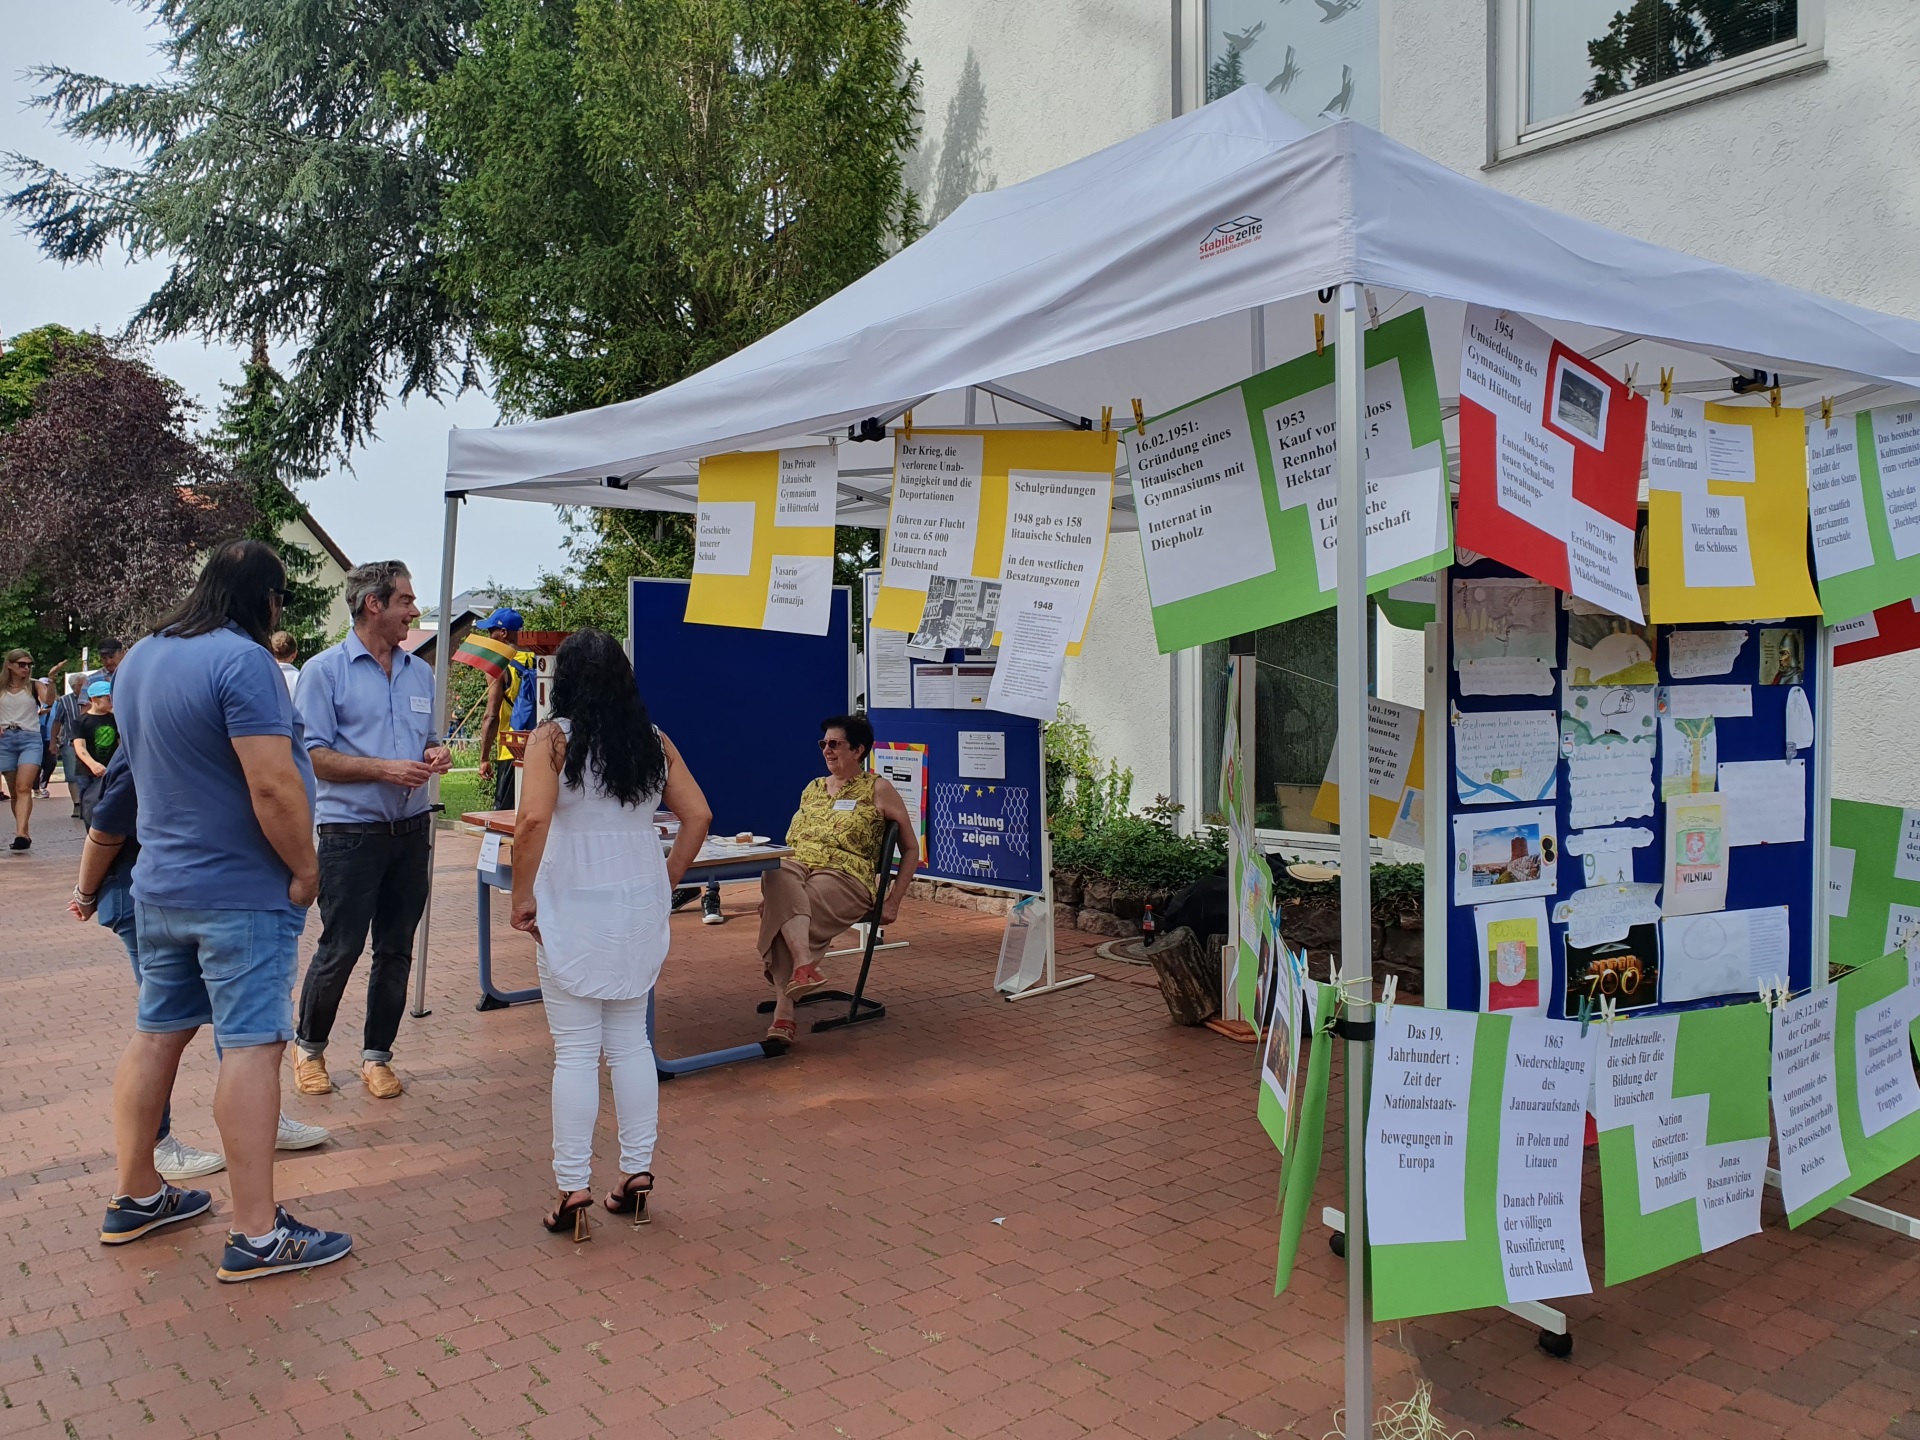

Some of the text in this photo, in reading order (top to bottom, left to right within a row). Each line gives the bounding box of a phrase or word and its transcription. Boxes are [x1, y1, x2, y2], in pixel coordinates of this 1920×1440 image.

[1200, 224, 1262, 254] stabilezelte
[1200, 235, 1261, 260] www.stabilezelte.de
[1494, 319, 1514, 340] 1954
[1470, 324, 1538, 377] Umsiedelung des
[1468, 345, 1521, 388] Gymnasiums
[1466, 367, 1531, 414] nach Hüttenfeld
[1276, 410, 1305, 432] 1953
[1671, 408, 1683, 419] 1984
[1135, 421, 1199, 454] 16.02.1951:
[1651, 421, 1697, 439] Beschädigung des
[1279, 427, 1311, 451] Kauf
[1524, 431, 1548, 454] 1963-65
[1651, 437, 1692, 453] Schlosses durch
[1878, 434, 1890, 444] Das
[902, 445, 956, 457] Der Krieg, die
[1138, 428, 1231, 471] Gründung eines
[1502, 434, 1555, 474] Entstehung eines
[782, 459, 816, 470] Das Private
[902, 460, 964, 472] verlorene Unab-
[1502, 452, 1521, 470] neuen
[1652, 455, 1697, 470] einen Großbrand
[782, 474, 812, 484] Litauische
[901, 475, 972, 488] hängigkeit und die
[1141, 459, 1203, 489] litauischen
[1286, 464, 1331, 488] Hektar
[1841, 473, 1857, 485] Status
[1015, 482, 1096, 497] Schulgründungen
[1144, 461, 1245, 506] Gymnasiums mit
[1906, 485, 1916, 494] das
[781, 489, 816, 501] Gymnasium
[899, 489, 954, 502] Deportationen
[1502, 485, 1532, 507] gebäudes
[780, 502, 819, 513] in Hüttenfeld
[1705, 507, 1720, 518] 1989
[1814, 506, 1827, 516] einer
[701, 512, 710, 521] Die
[897, 515, 965, 529] führen zur Flucht
[1013, 513, 1033, 524] 1948
[1035, 516, 1051, 528] gab
[1066, 517, 1082, 527] 158
[1149, 504, 1212, 534] Internat in
[700, 526, 730, 535] Geschichte
[895, 531, 949, 542] von ca. 65 000
[1011, 528, 1092, 545] litauische Schulen
[1151, 526, 1204, 551] Diepholz
[1585, 521, 1616, 545] 1972/1987
[1692, 524, 1738, 536] Wiederaufbau
[699, 540, 720, 548] unserer
[1571, 530, 1618, 564] Errichtung des
[1695, 542, 1738, 553] des Schlosses
[1817, 531, 1851, 548] Ersatzschule
[698, 552, 716, 561] Schule
[893, 543, 947, 558] Litauern nach
[775, 566, 797, 576] Vasario
[891, 557, 938, 572] Deutschland
[1008, 555, 1084, 572] in den westlichen
[774, 581, 797, 590] 16-osios
[1006, 570, 1080, 588] Besatzungszonen
[1574, 565, 1633, 602] Mädcheninternats
[771, 594, 803, 607] Gimnazija
[1033, 601, 1053, 610] 1948
[1383, 770, 1395, 778] die
[958, 812, 1004, 831] Haltung
[962, 830, 1000, 847] zeigen
[1683, 872, 1712, 883] VILNIAU
[1584, 967, 1639, 1001] 700
[1407, 1024, 1443, 1041] Das 19.
[1788, 1020, 1822, 1041] der Große
[1544, 1034, 1564, 1049] 1863
[1609, 1031, 1662, 1049] Intellektuelle
[1388, 1047, 1450, 1065] Jahrhundert
[1515, 1054, 1585, 1073] Niederschlagung
[1607, 1051, 1665, 1069] die sich für die
[1787, 1051, 1820, 1076] erklärt die
[1403, 1072, 1442, 1087] Zeit der
[1542, 1078, 1556, 1091] des
[1612, 1070, 1658, 1088] Bildung der
[1782, 1073, 1828, 1104] Autonomie des
[1384, 1094, 1456, 1111] Nationalstaats-
[1509, 1097, 1580, 1112] Januaraufstands
[1613, 1090, 1654, 1107] litauischen
[1790, 1093, 1823, 1118] litauischen
[1658, 1113, 1683, 1128] Nation
[1781, 1103, 1834, 1141] Staates innerhalb
[1380, 1129, 1453, 1148] bewegungen in
[1516, 1132, 1569, 1148] in Polen und
[1652, 1132, 1689, 1149] einsetzten:
[1787, 1124, 1832, 1156] des Russischen
[1398, 1154, 1435, 1172] Europa
[1525, 1155, 1558, 1168] Litauen
[1653, 1150, 1689, 1170] Kristijonas
[1719, 1156, 1741, 1169] Jonas
[1801, 1154, 1825, 1175] Reiches
[1655, 1170, 1687, 1189] Donelaitis
[1707, 1171, 1752, 1190] Basanavicius
[1503, 1192, 1564, 1208] Danach Politik
[1703, 1188, 1755, 1210] Vincas Kudirka
[1504, 1216, 1552, 1232] der völligen
[277, 1238, 308, 1261] N
[1506, 1237, 1565, 1254] Russifizierung
[1509, 1258, 1574, 1278] durch Russland
